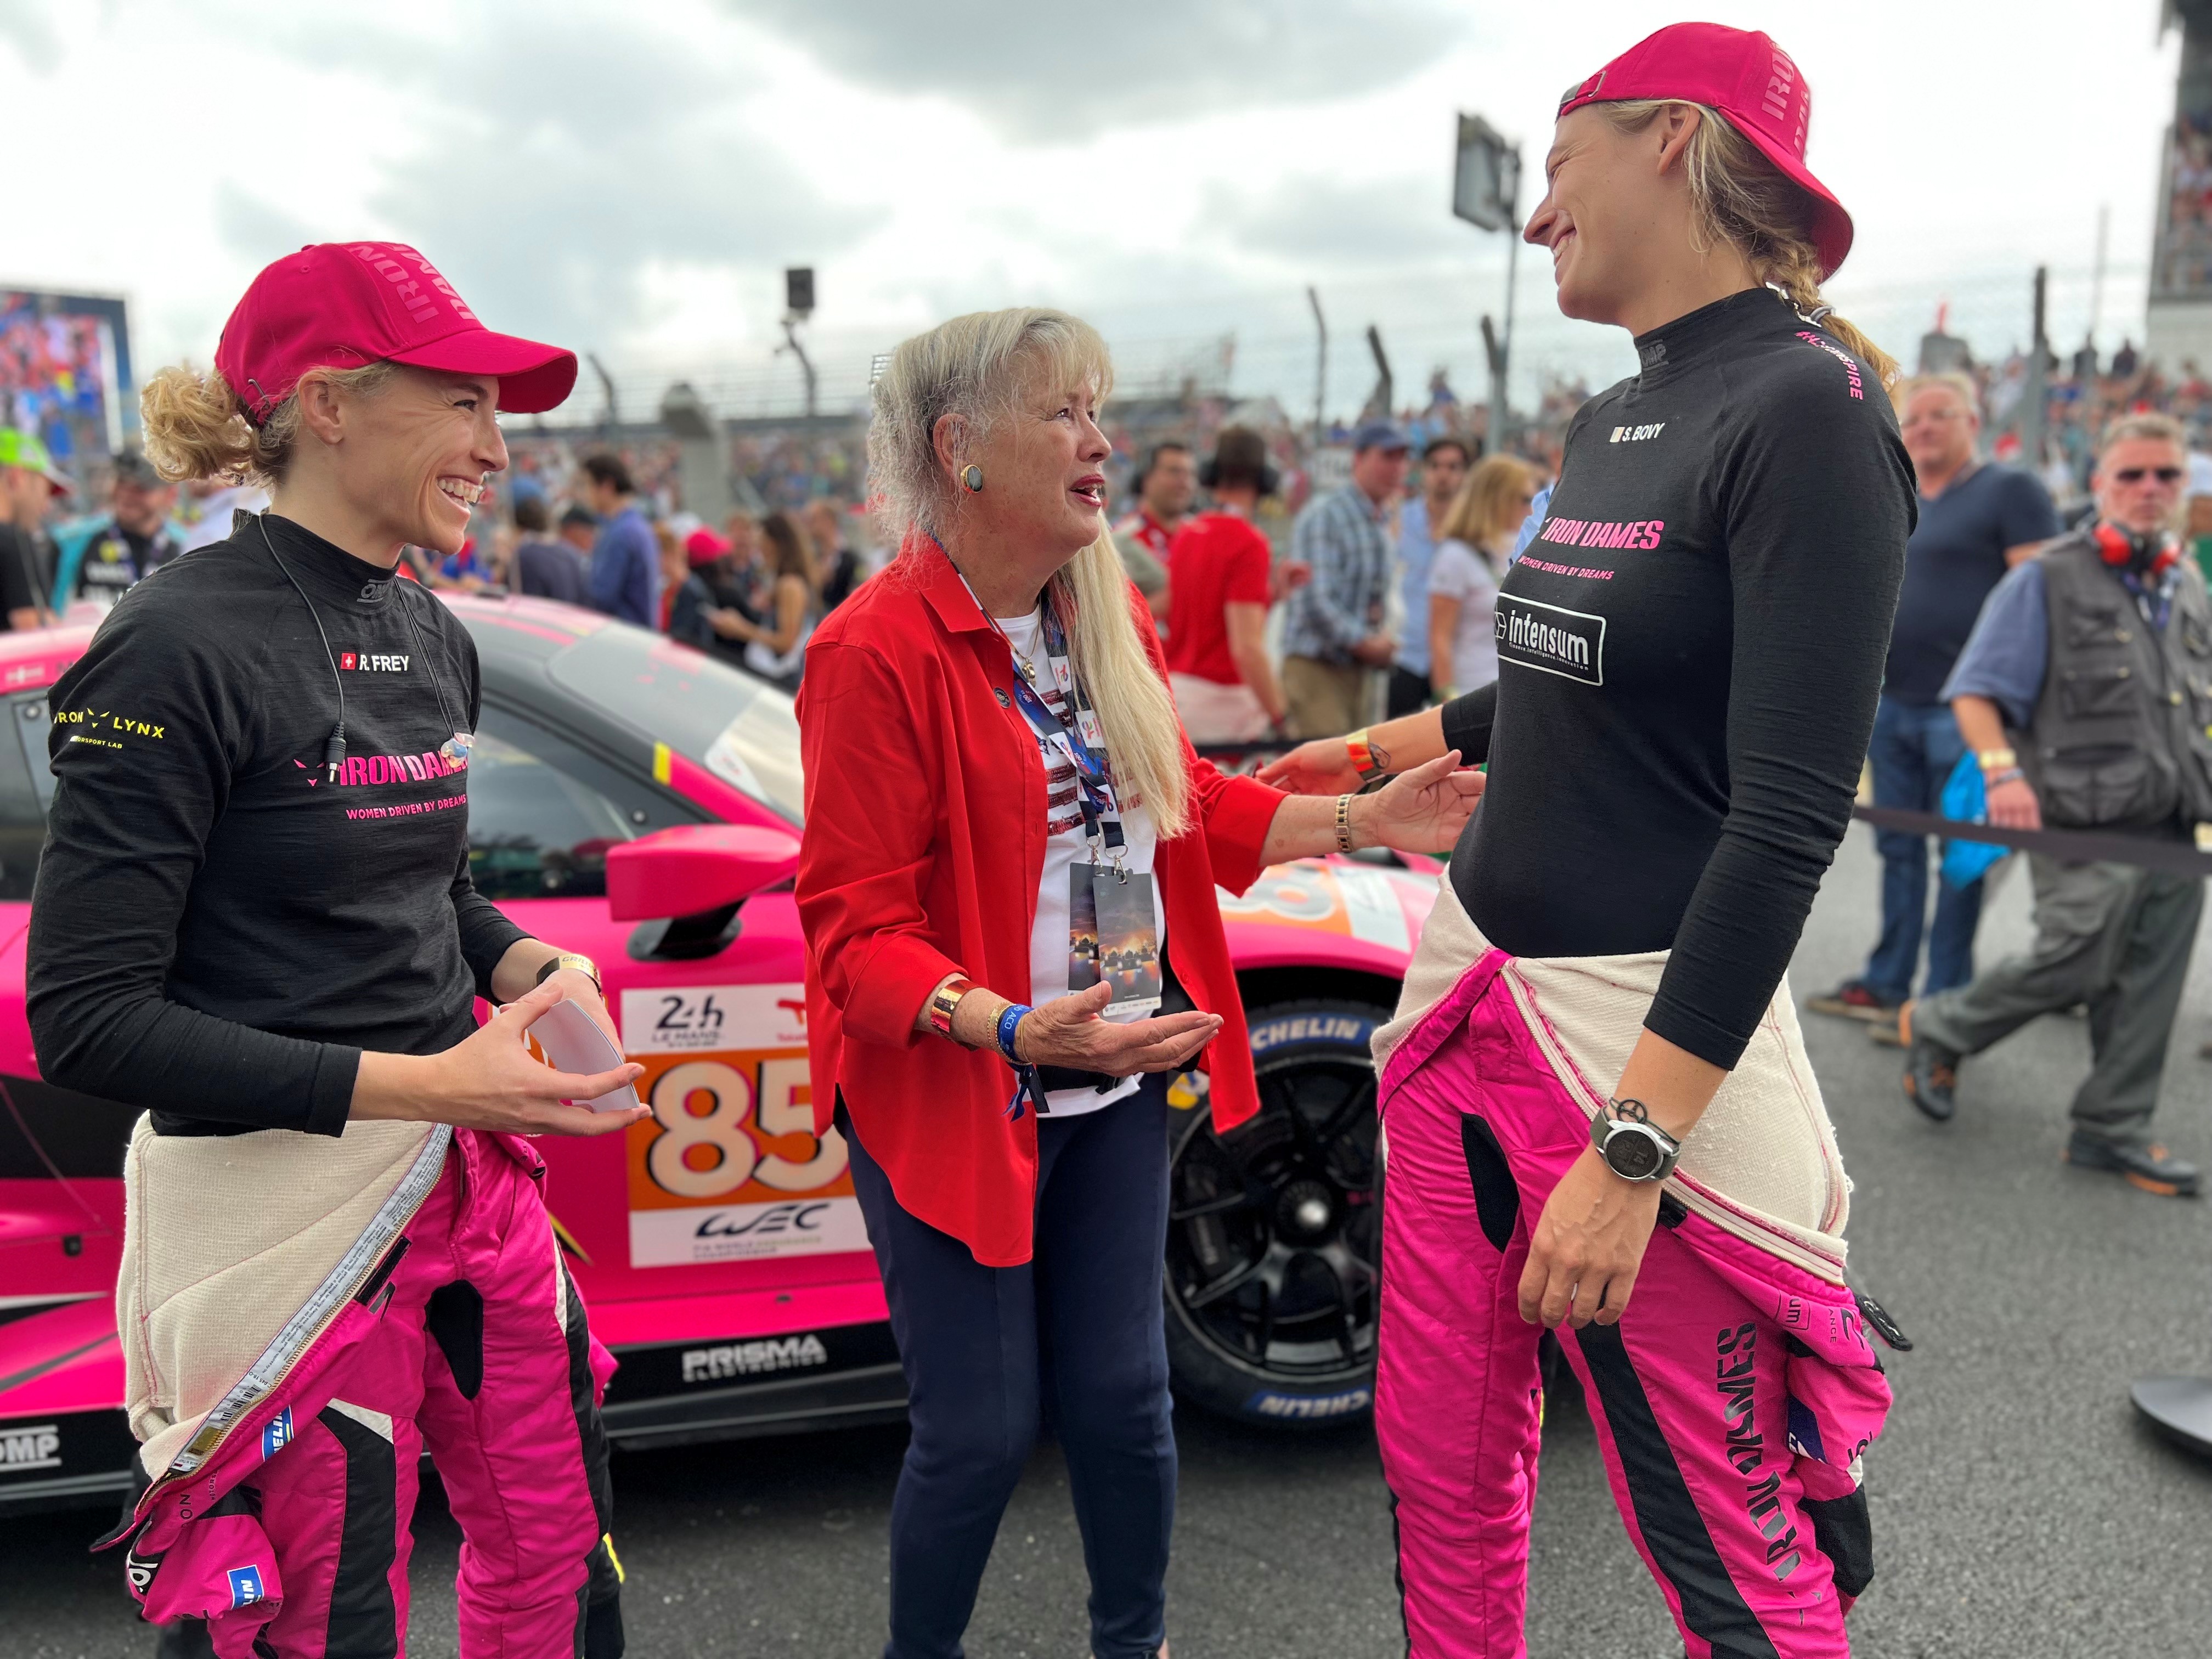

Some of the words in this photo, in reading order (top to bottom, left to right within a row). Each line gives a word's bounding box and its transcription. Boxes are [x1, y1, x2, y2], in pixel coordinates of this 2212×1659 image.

[1762, 42, 1794, 121] IRO
[348, 245, 439, 324] IRON
[1622, 426, 1633, 442] S.
[1632, 422, 1666, 441] BOVY
[1541, 516, 1589, 545] IRON
[1579, 520, 1665, 550] DAMES
[1518, 554, 1542, 570] WOMEN
[1541, 562, 1567, 576] DRIVEN
[1566, 566, 1580, 577] BY
[1578, 567, 1615, 580] DREAMS
[1509, 610, 1589, 665] intensum
[359, 654, 370, 671] R.
[371, 655, 409, 672] FREY
[70, 736, 106, 746] ORSPORT
[113, 716, 165, 739] LYNX
[339, 755, 408, 786] IRON
[346, 807, 387, 820] WOMEN
[388, 803, 423, 817] DRIVEN
[424, 801, 436, 812] BY
[437, 794, 467, 810] DREAMS
[1004, 1011, 1017, 1030] ACO
[1250, 1018, 1362, 1051] CHELIN
[646, 1057, 850, 1198] 85
[694, 1202, 832, 1238] WEC
[682, 1333, 827, 1370] PRISMA
[1258, 1390, 1370, 1418] CHELIN
